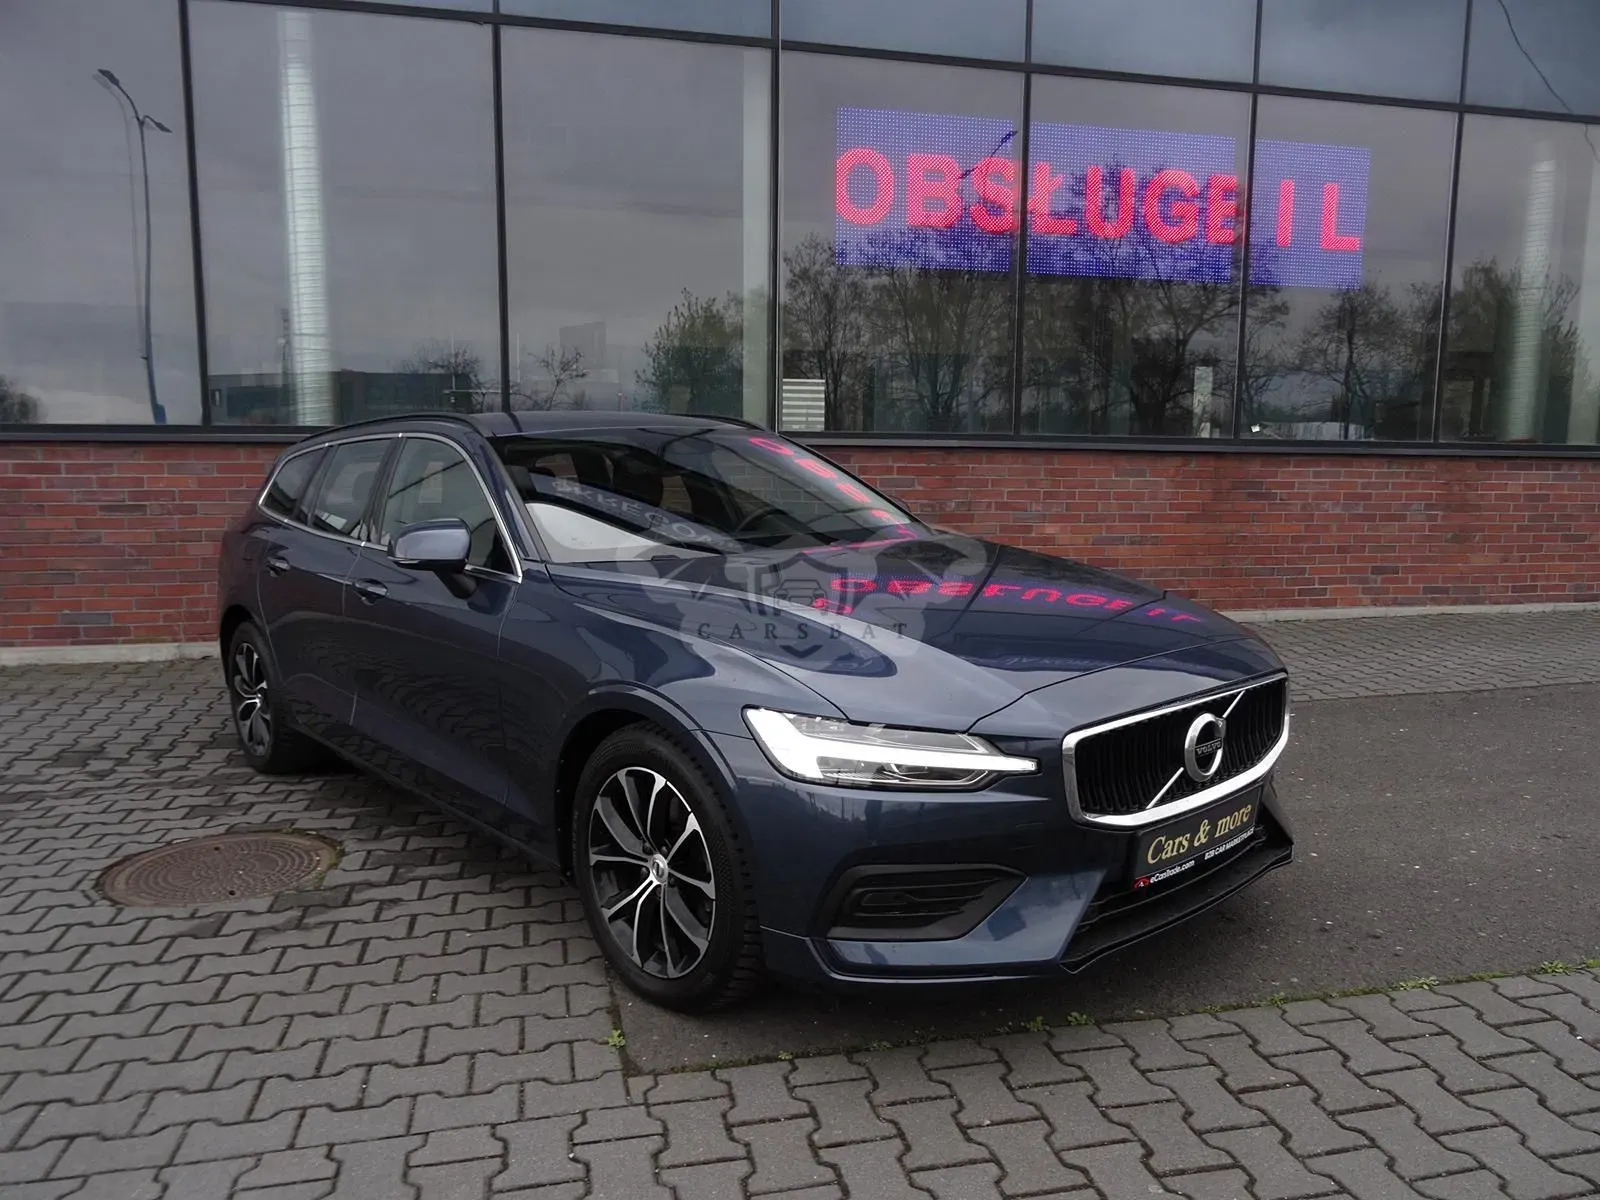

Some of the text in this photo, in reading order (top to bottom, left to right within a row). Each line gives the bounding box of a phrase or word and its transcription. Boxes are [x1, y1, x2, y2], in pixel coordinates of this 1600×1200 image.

[1275, 178, 1295, 248] I
[1320, 183, 1361, 251] L
[1196, 741, 1221, 754] VOLVO
[1147, 804, 1252, 864] Cars & more
